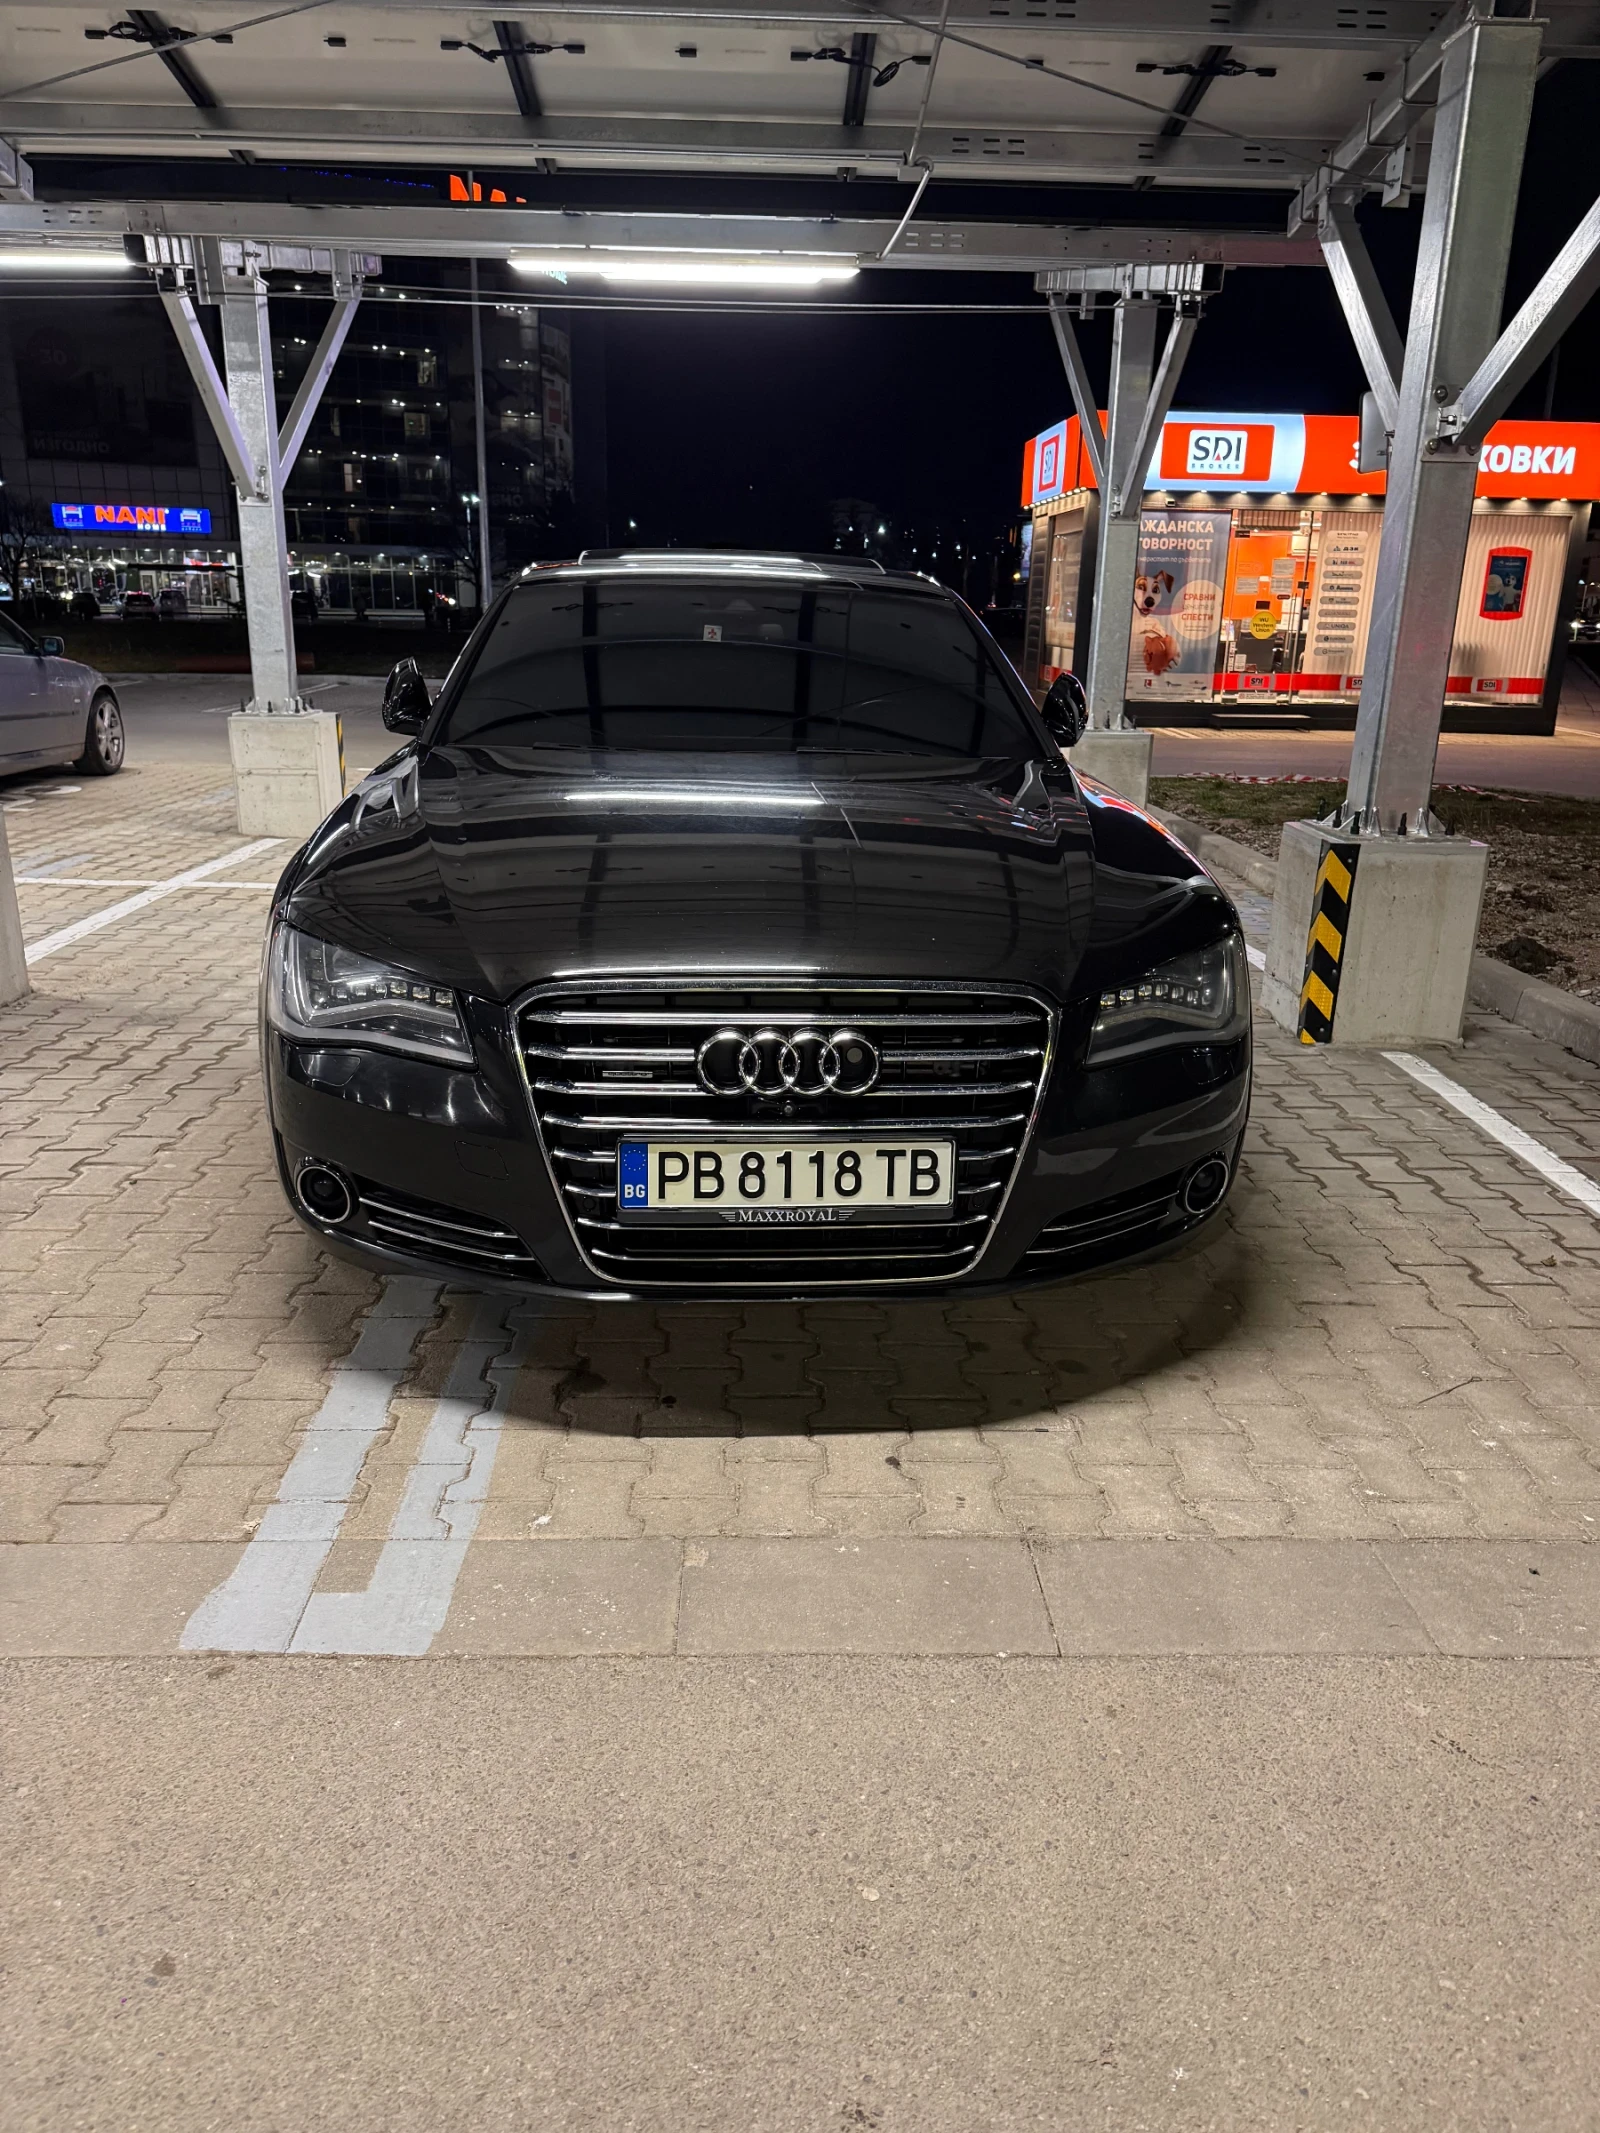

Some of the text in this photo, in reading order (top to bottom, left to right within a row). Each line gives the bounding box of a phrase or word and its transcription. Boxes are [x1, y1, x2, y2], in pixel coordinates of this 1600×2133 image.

[1193, 436, 1242, 461] SDI
[94, 505, 166, 525] NANI
[137, 523, 167, 532] HOME
[1139, 537, 1213, 551] ОВОРНОСТ
[1183, 593, 1216, 601] СРАВНИ
[1182, 613, 1213, 621] СПЕСТИ
[658, 1149, 940, 1200] PB 8118 TB
[624, 1184, 646, 1199] BG
